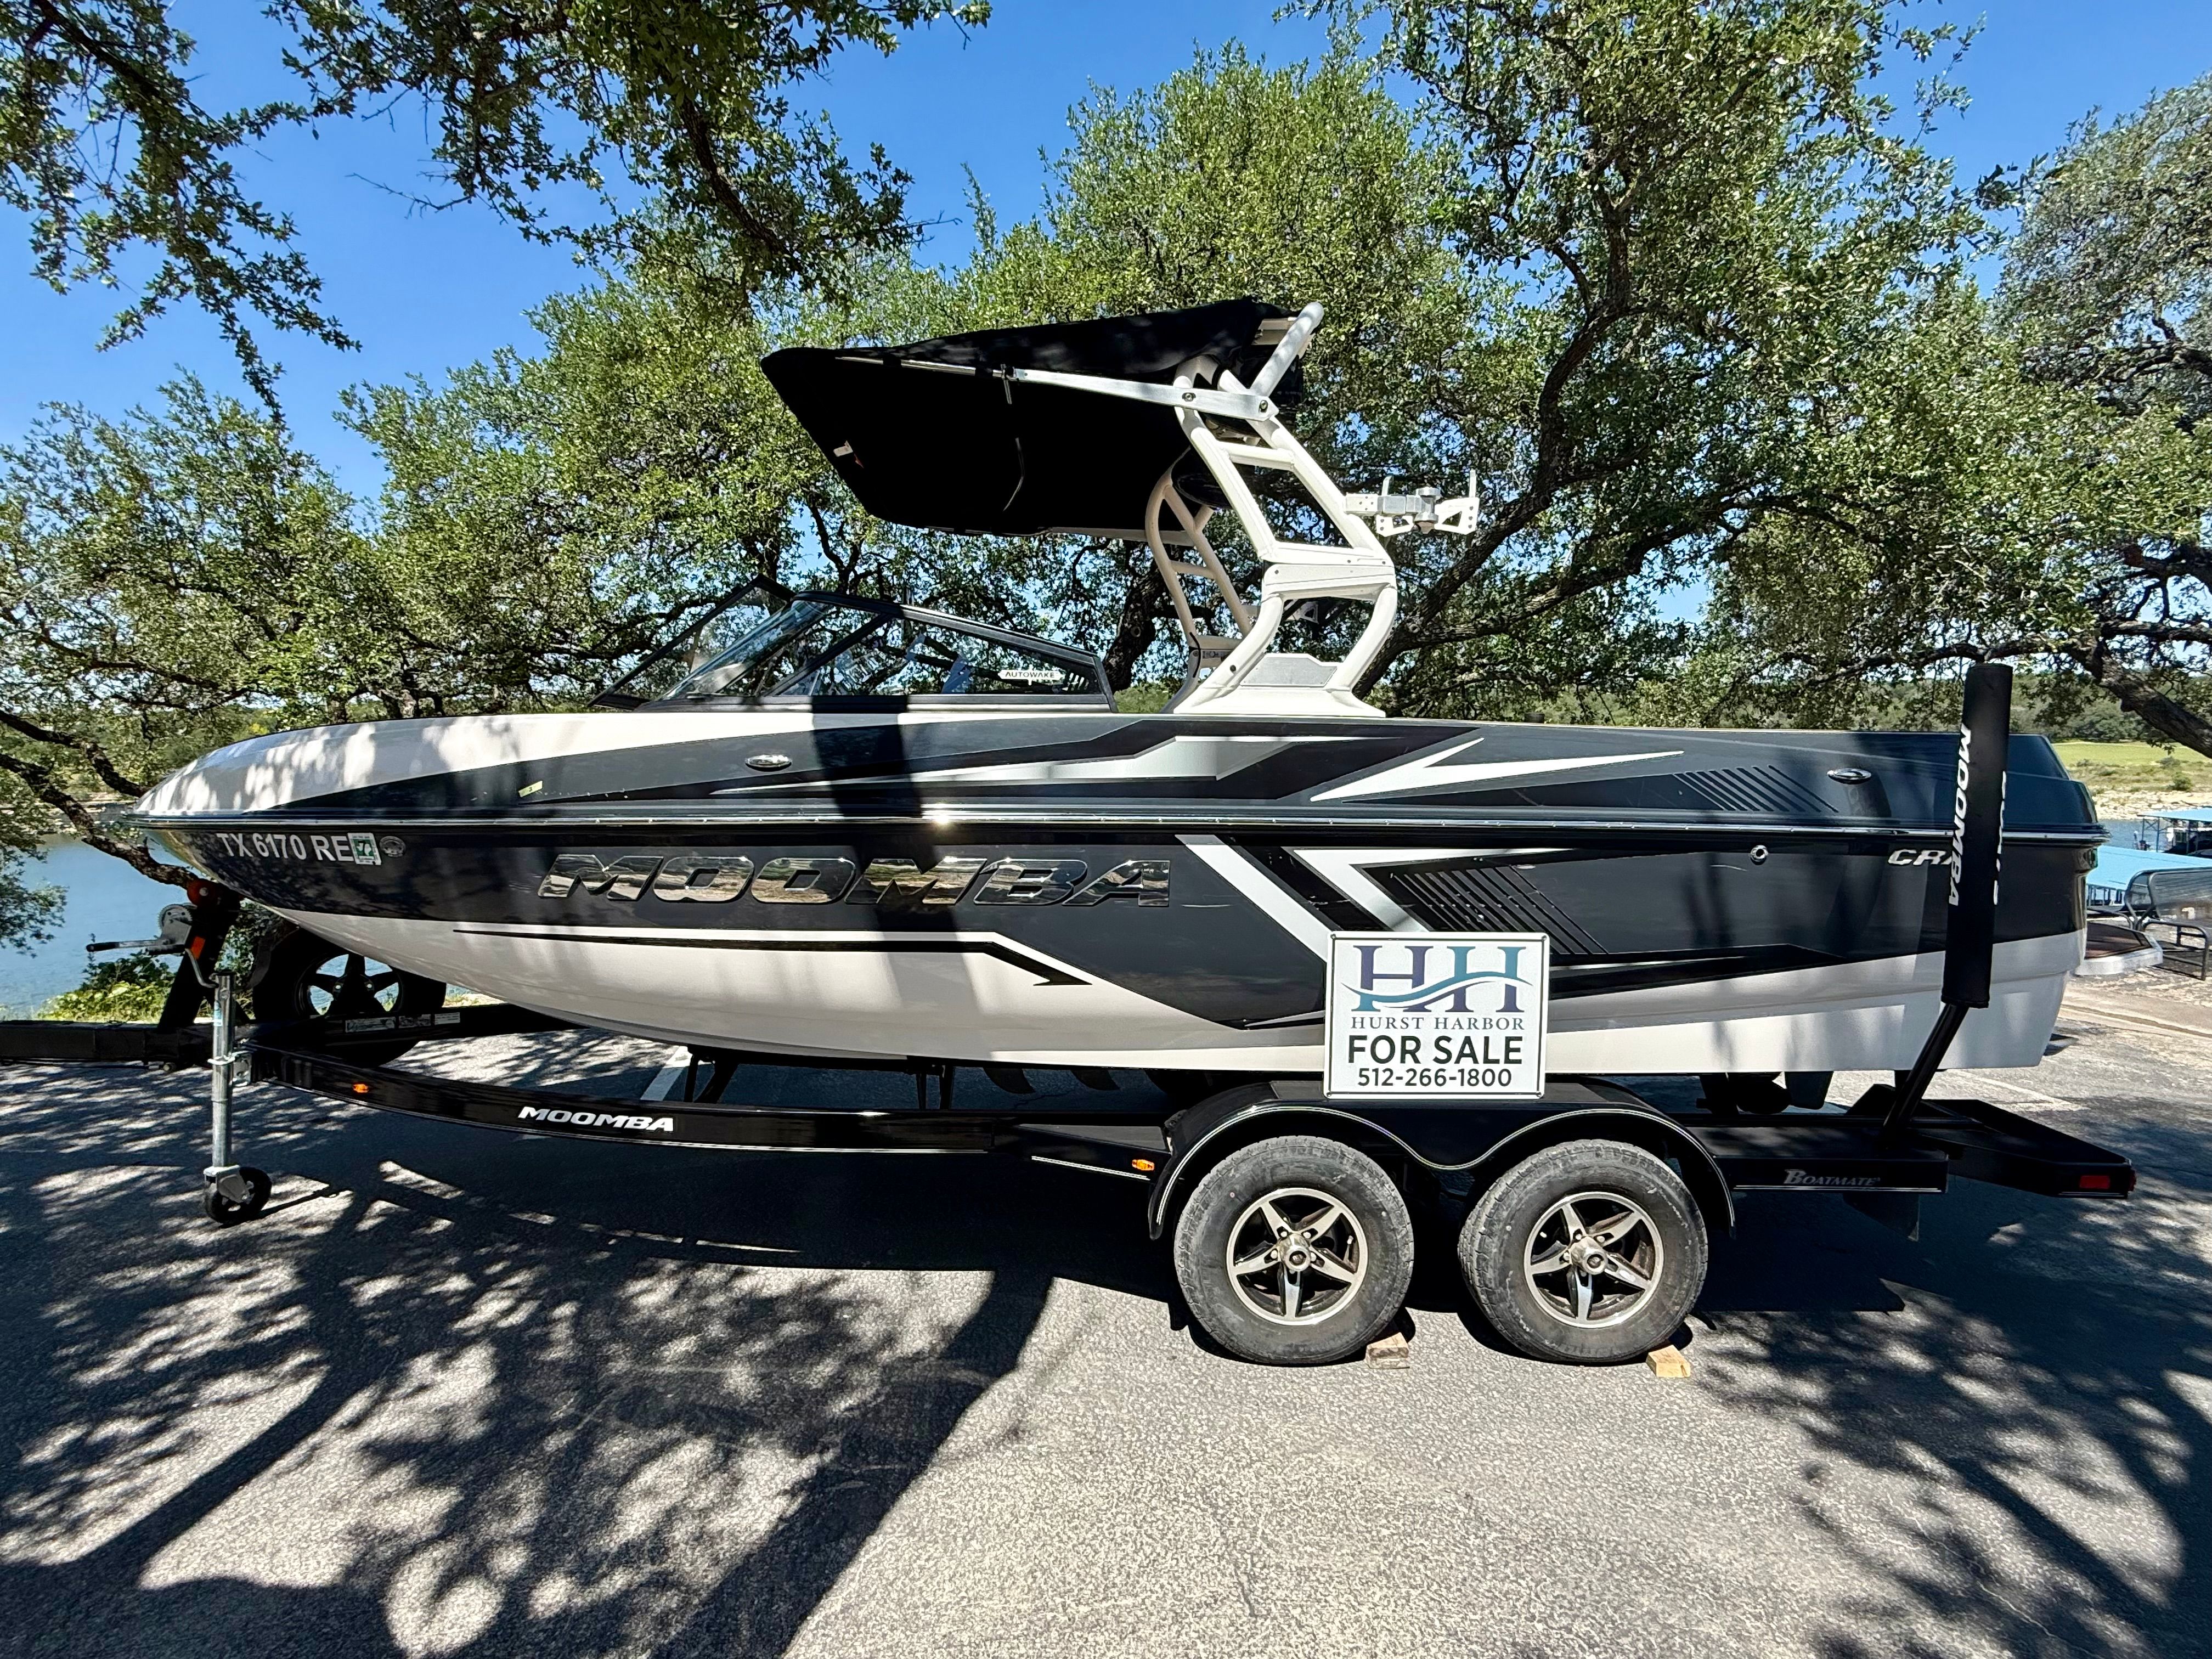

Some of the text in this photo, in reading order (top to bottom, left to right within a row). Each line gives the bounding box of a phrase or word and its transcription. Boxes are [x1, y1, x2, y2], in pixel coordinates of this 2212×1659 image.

[1949, 724, 1971, 906] MOOMBA
[216, 833, 253, 857] TX
[252, 833, 307, 860] 6170
[311, 835, 354, 861] RE
[538, 853, 1170, 907] MOOMBA
[1351, 1017, 1525, 1030] HURST HARBOR
[1348, 1035, 1523, 1065] FOR SALE
[1358, 1068, 1512, 1087] 512-266-1800
[518, 1106, 674, 1132] MOOMBA
